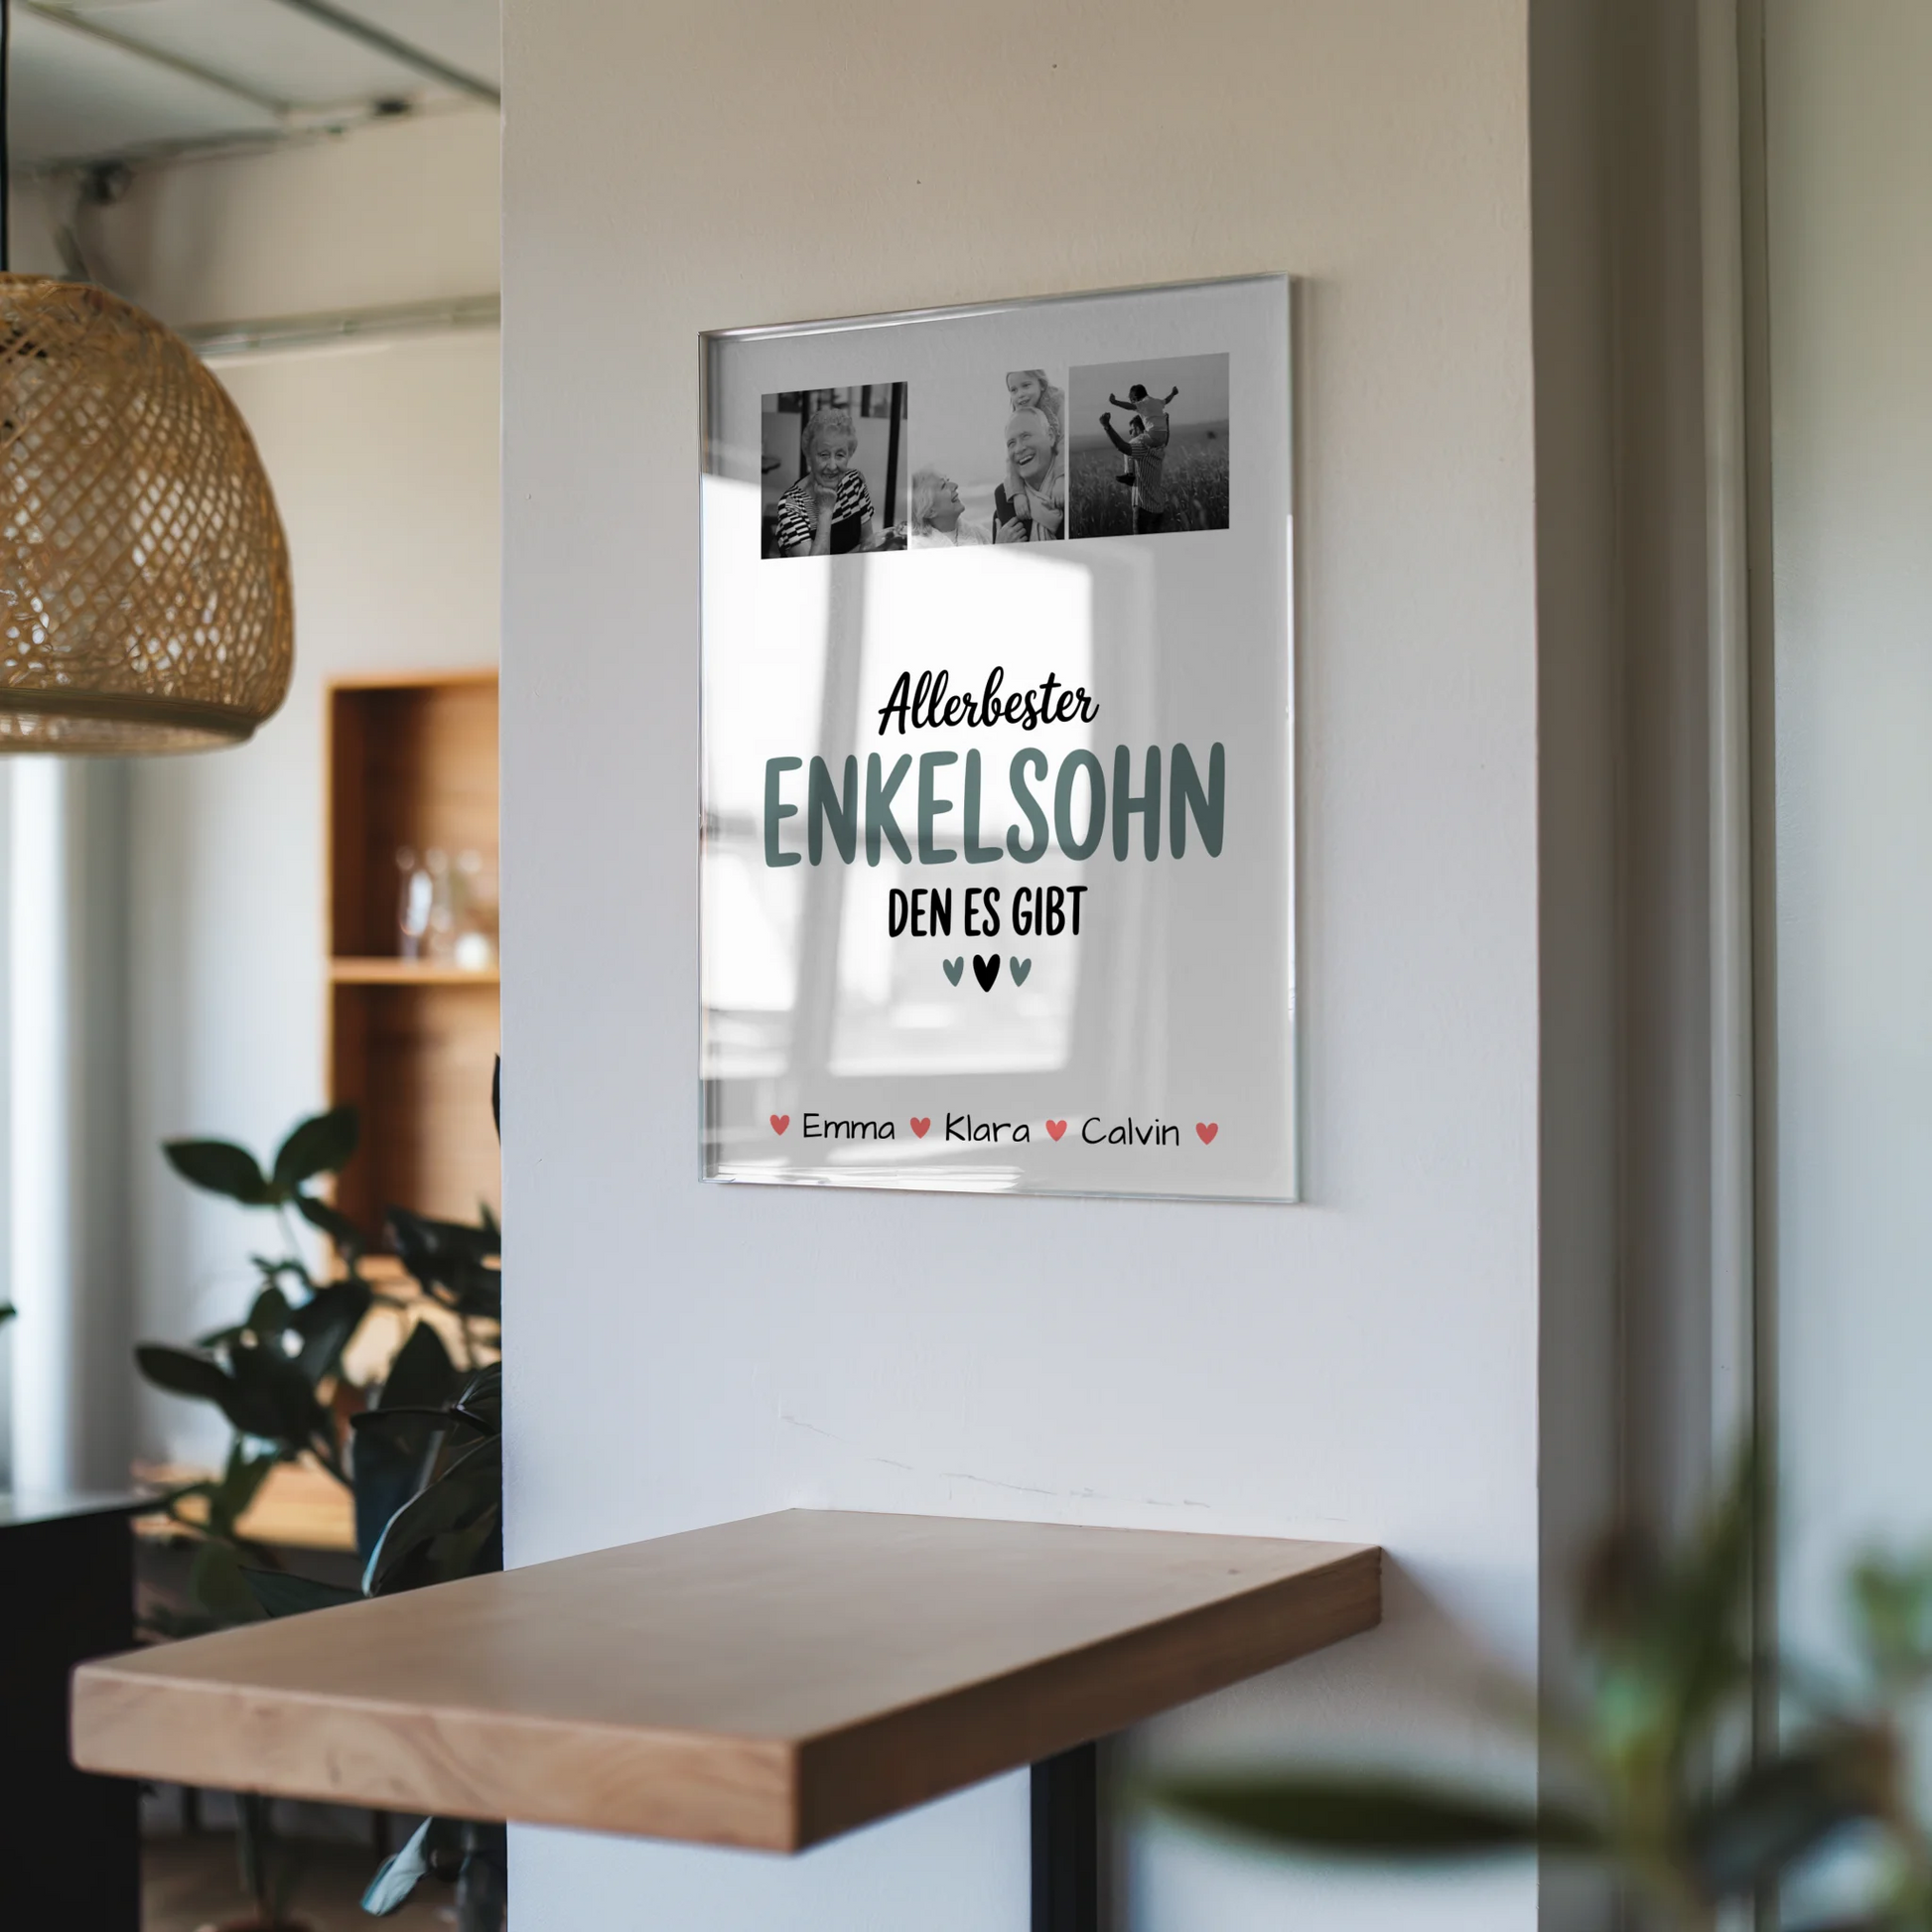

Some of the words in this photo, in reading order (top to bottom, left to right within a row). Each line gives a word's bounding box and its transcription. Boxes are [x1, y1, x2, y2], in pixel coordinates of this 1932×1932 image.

[878, 665, 1100, 736] Allerbester
[763, 741, 1226, 868] ENKELSOHN
[888, 887, 952, 938] DEN
[964, 887, 1001, 937] ES
[1012, 885, 1089, 936] GIBT
[802, 1112, 896, 1140] Emma
[945, 1112, 1031, 1143] Klara
[1081, 1117, 1180, 1147] Calvin
